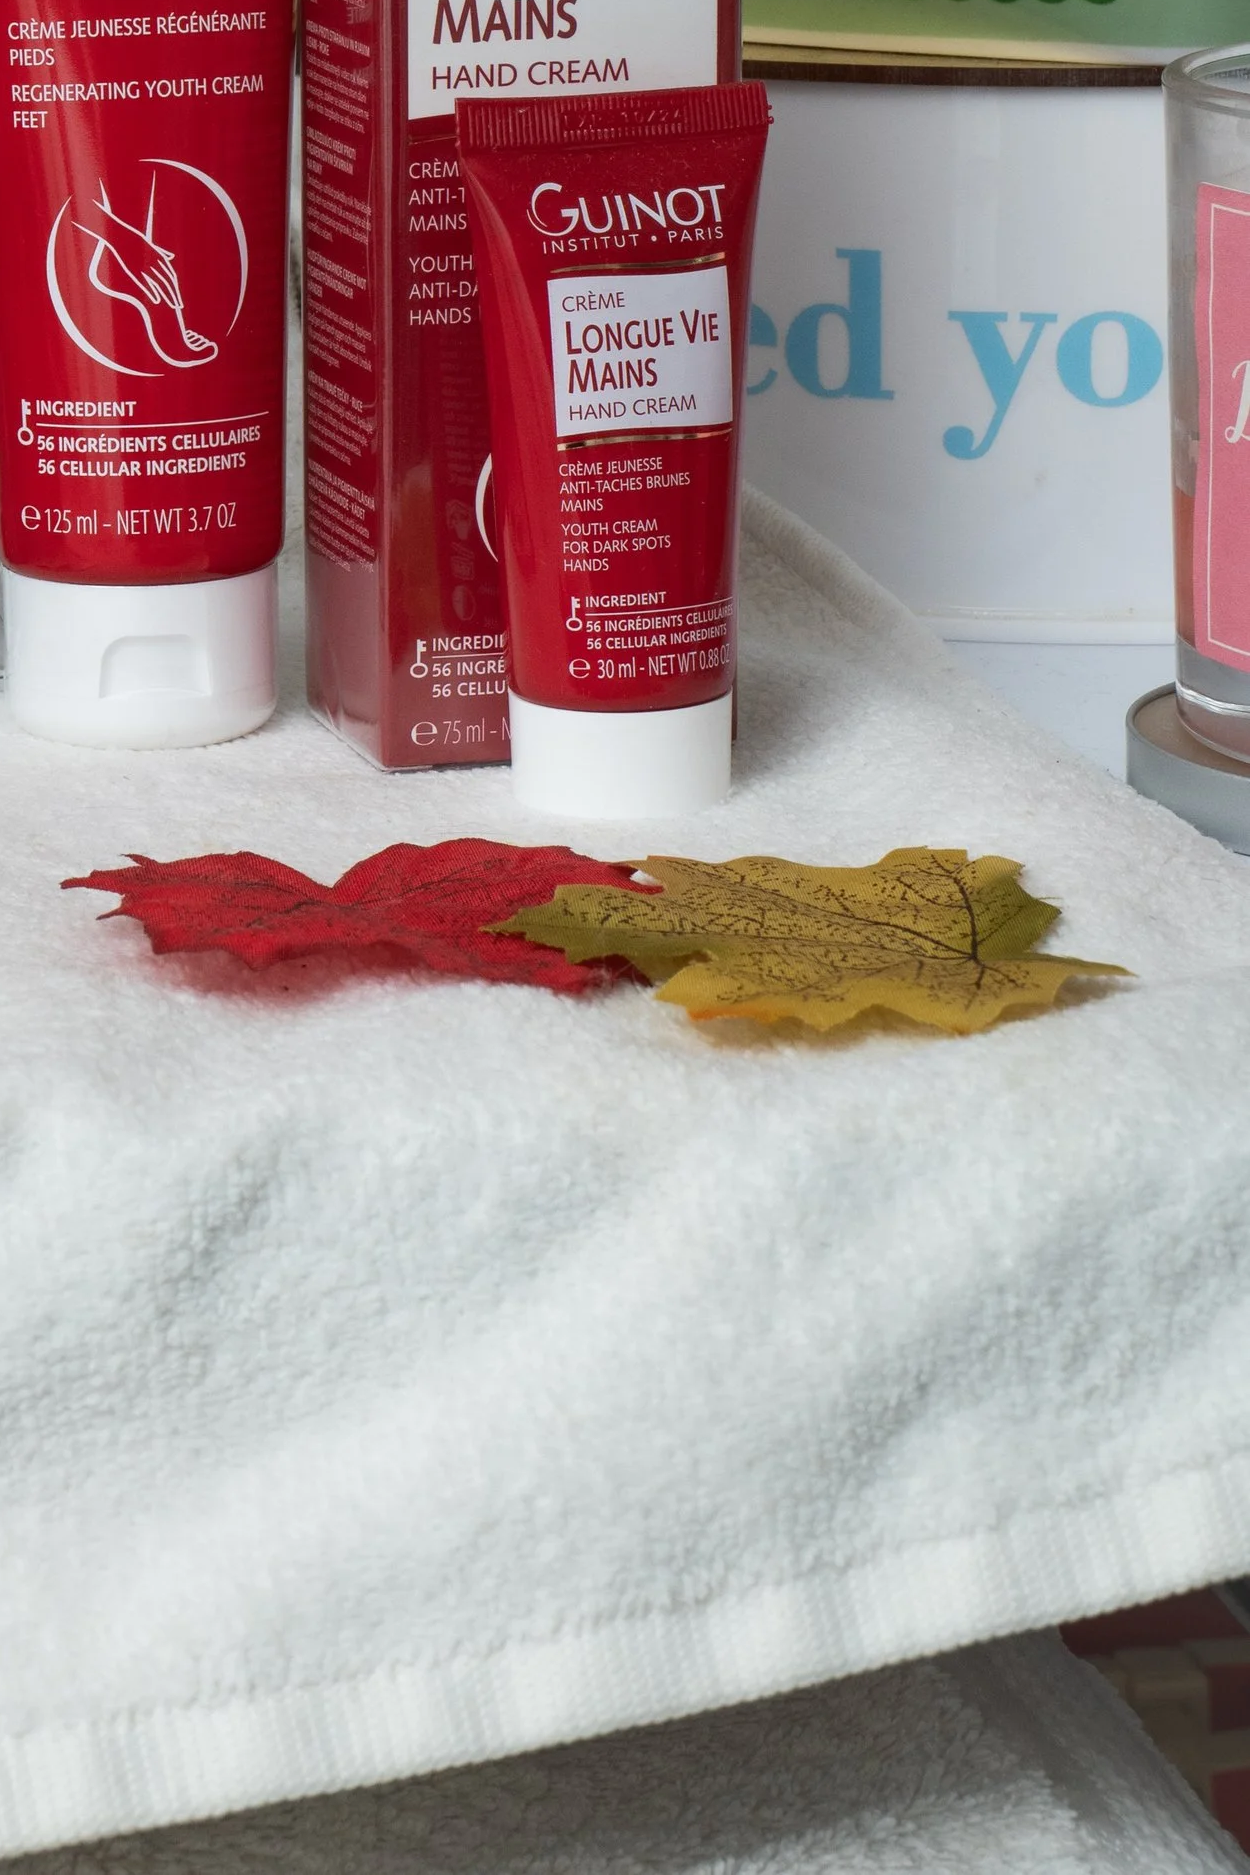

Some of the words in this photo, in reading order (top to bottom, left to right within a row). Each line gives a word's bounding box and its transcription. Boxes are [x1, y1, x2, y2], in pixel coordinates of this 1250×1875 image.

[7, 18, 66, 40] CRÈME
[70, 16, 151, 39] JEUNESSE
[156, 10, 267, 34] RÉGÉNÉRANTE
[9, 48, 55, 66] PIEDS
[431, 63, 518, 90] HAND
[527, 58, 630, 86] CREAM
[11, 81, 140, 103] REGENERATING
[145, 77, 207, 98] YOUTH
[211, 74, 264, 94] CREAM
[12, 110, 48, 128] FEET
[526, 182, 726, 237] GUINOT
[561, 291, 626, 313] CRÈME
[565, 317, 675, 356] LONGUE
[681, 309, 720, 342] VIE
[568, 357, 658, 394] MAINS
[943, 310, 1163, 460] yo
[35, 399, 137, 417] INGREDIENT
[568, 401, 627, 421] HAND
[632, 394, 697, 417] CREAM
[561, 522, 609, 537] YOUTH
[612, 518, 659, 534] CREAM
[563, 540, 589, 554] FOR
[593, 538, 629, 553] DARK
[632, 535, 671, 551] SPOTS
[563, 557, 610, 572] HANDS
